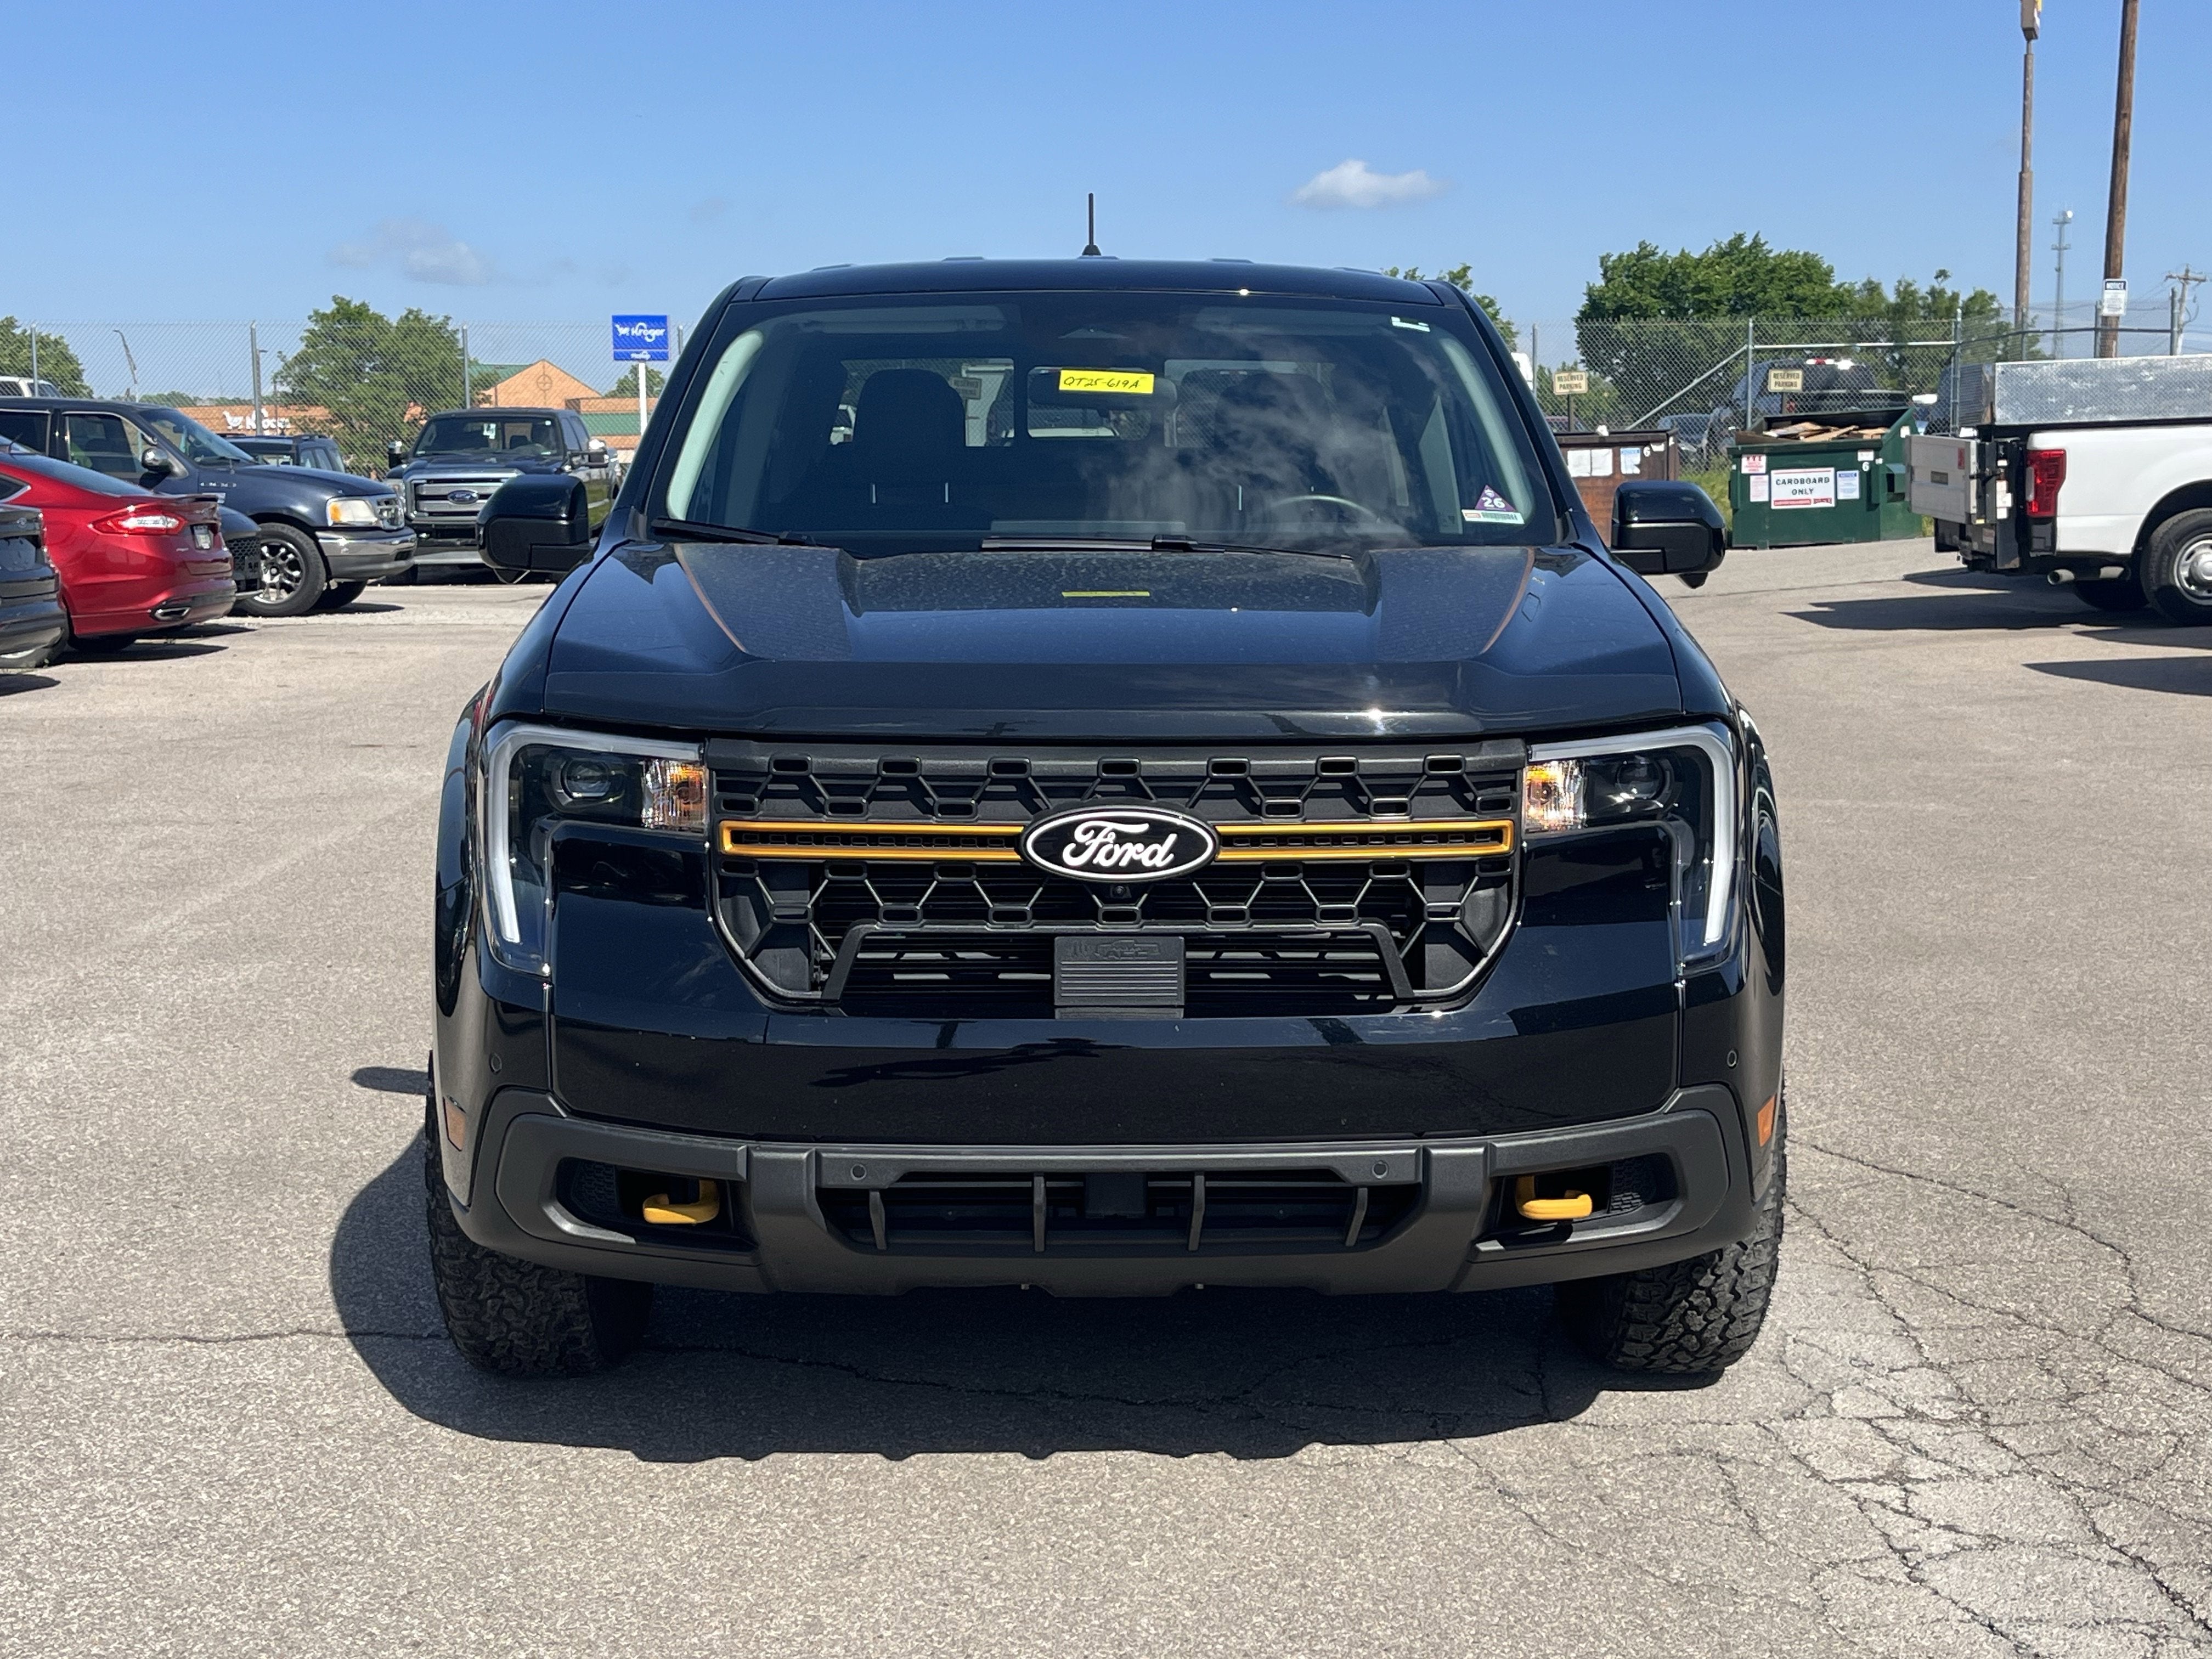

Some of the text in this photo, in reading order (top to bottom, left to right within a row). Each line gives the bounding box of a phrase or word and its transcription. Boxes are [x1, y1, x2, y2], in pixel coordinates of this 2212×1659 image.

[630, 322, 666, 342] Kroger
[1775, 477, 1830, 486] CARDBOARD
[1481, 497, 1505, 509] 26
[1062, 821, 1177, 867] Ford
